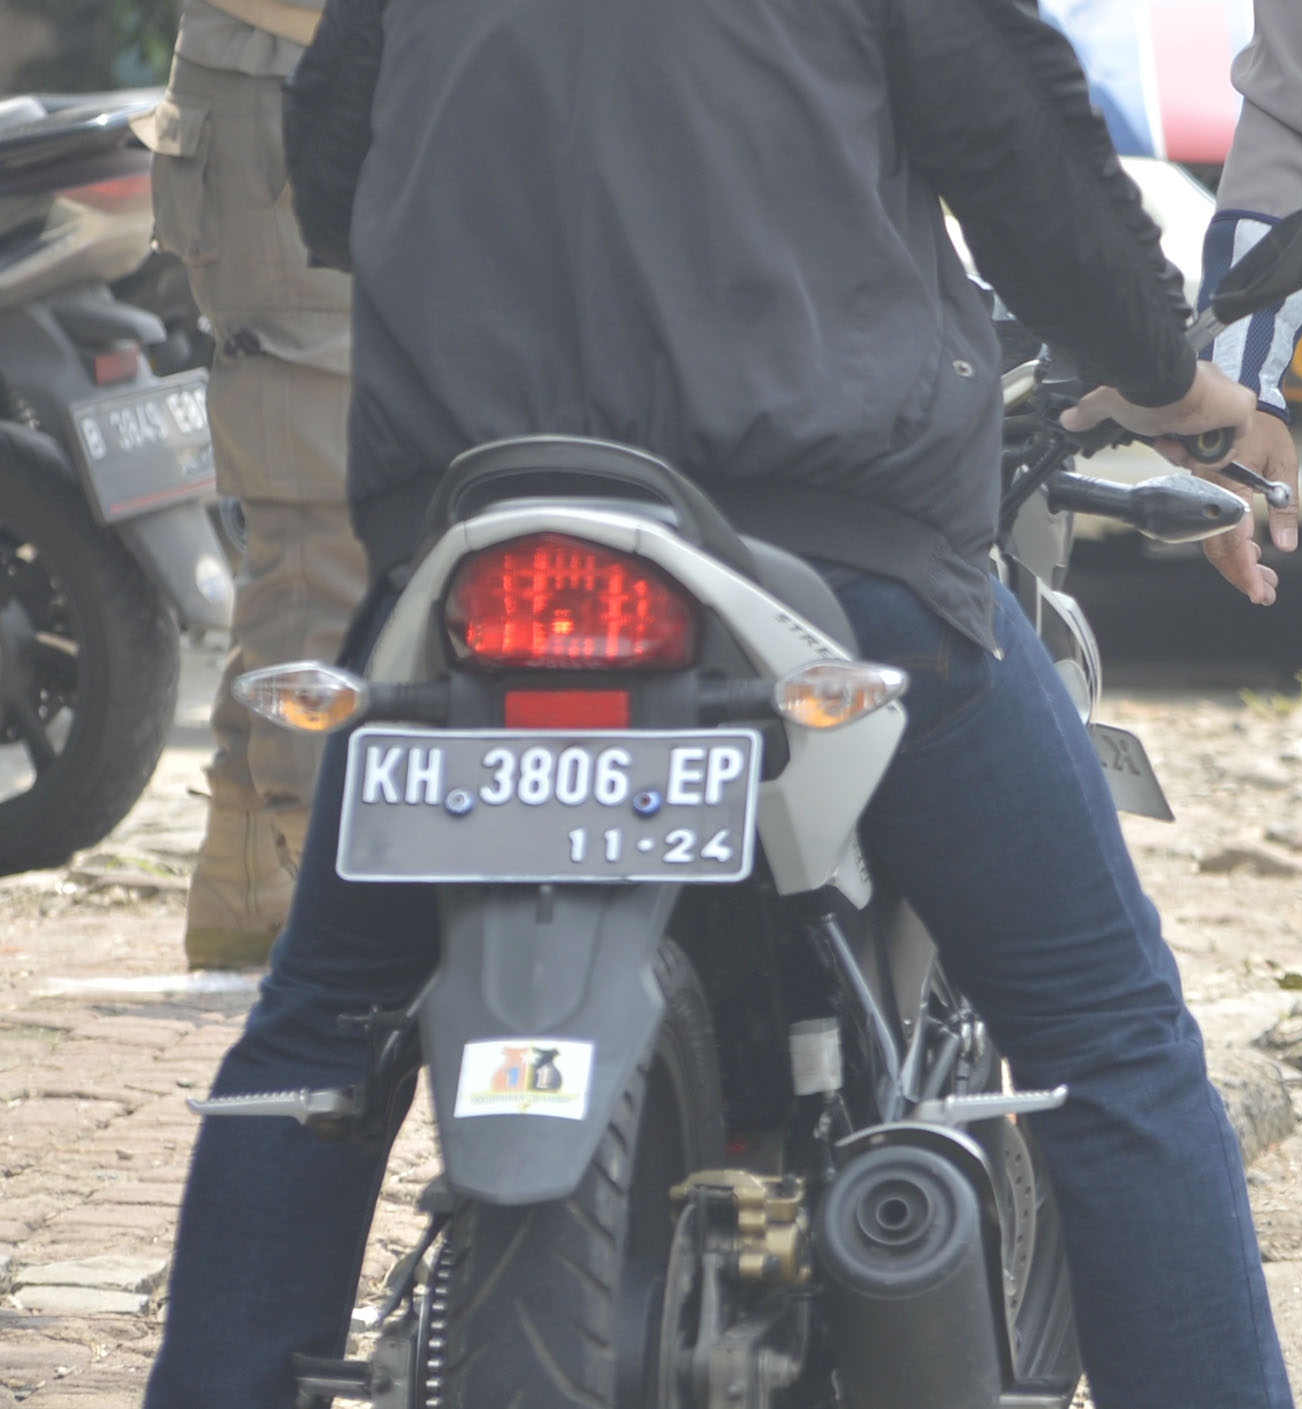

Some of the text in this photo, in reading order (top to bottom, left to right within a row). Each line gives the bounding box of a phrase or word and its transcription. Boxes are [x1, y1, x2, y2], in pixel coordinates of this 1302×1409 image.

[362, 746, 744, 806] KH 3806 EP
